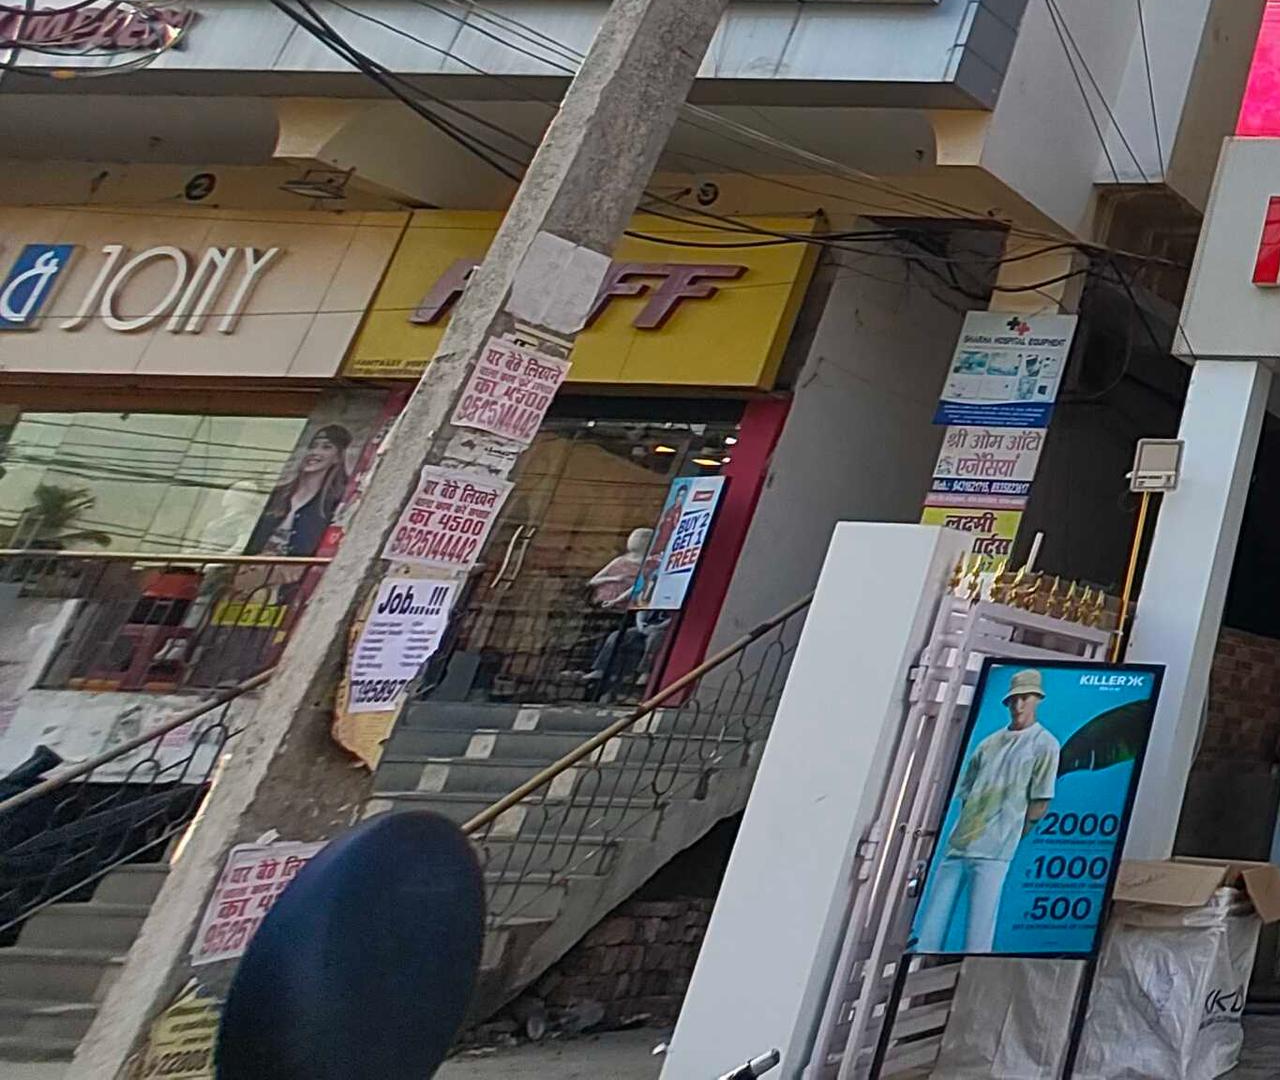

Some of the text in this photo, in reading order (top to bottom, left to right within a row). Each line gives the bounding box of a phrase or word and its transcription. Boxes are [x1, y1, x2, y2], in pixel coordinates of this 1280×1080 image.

[57, 244, 281, 334] JONY
[947, 428, 968, 448] श्री
[970, 430, 1004, 450] ओम
[460, 484, 499, 508] लिखने
[677, 516, 699, 535] BUY
[672, 532, 695, 552] GET
[665, 547, 700, 572] FREE
[1080, 675, 1127, 687] KILLER
